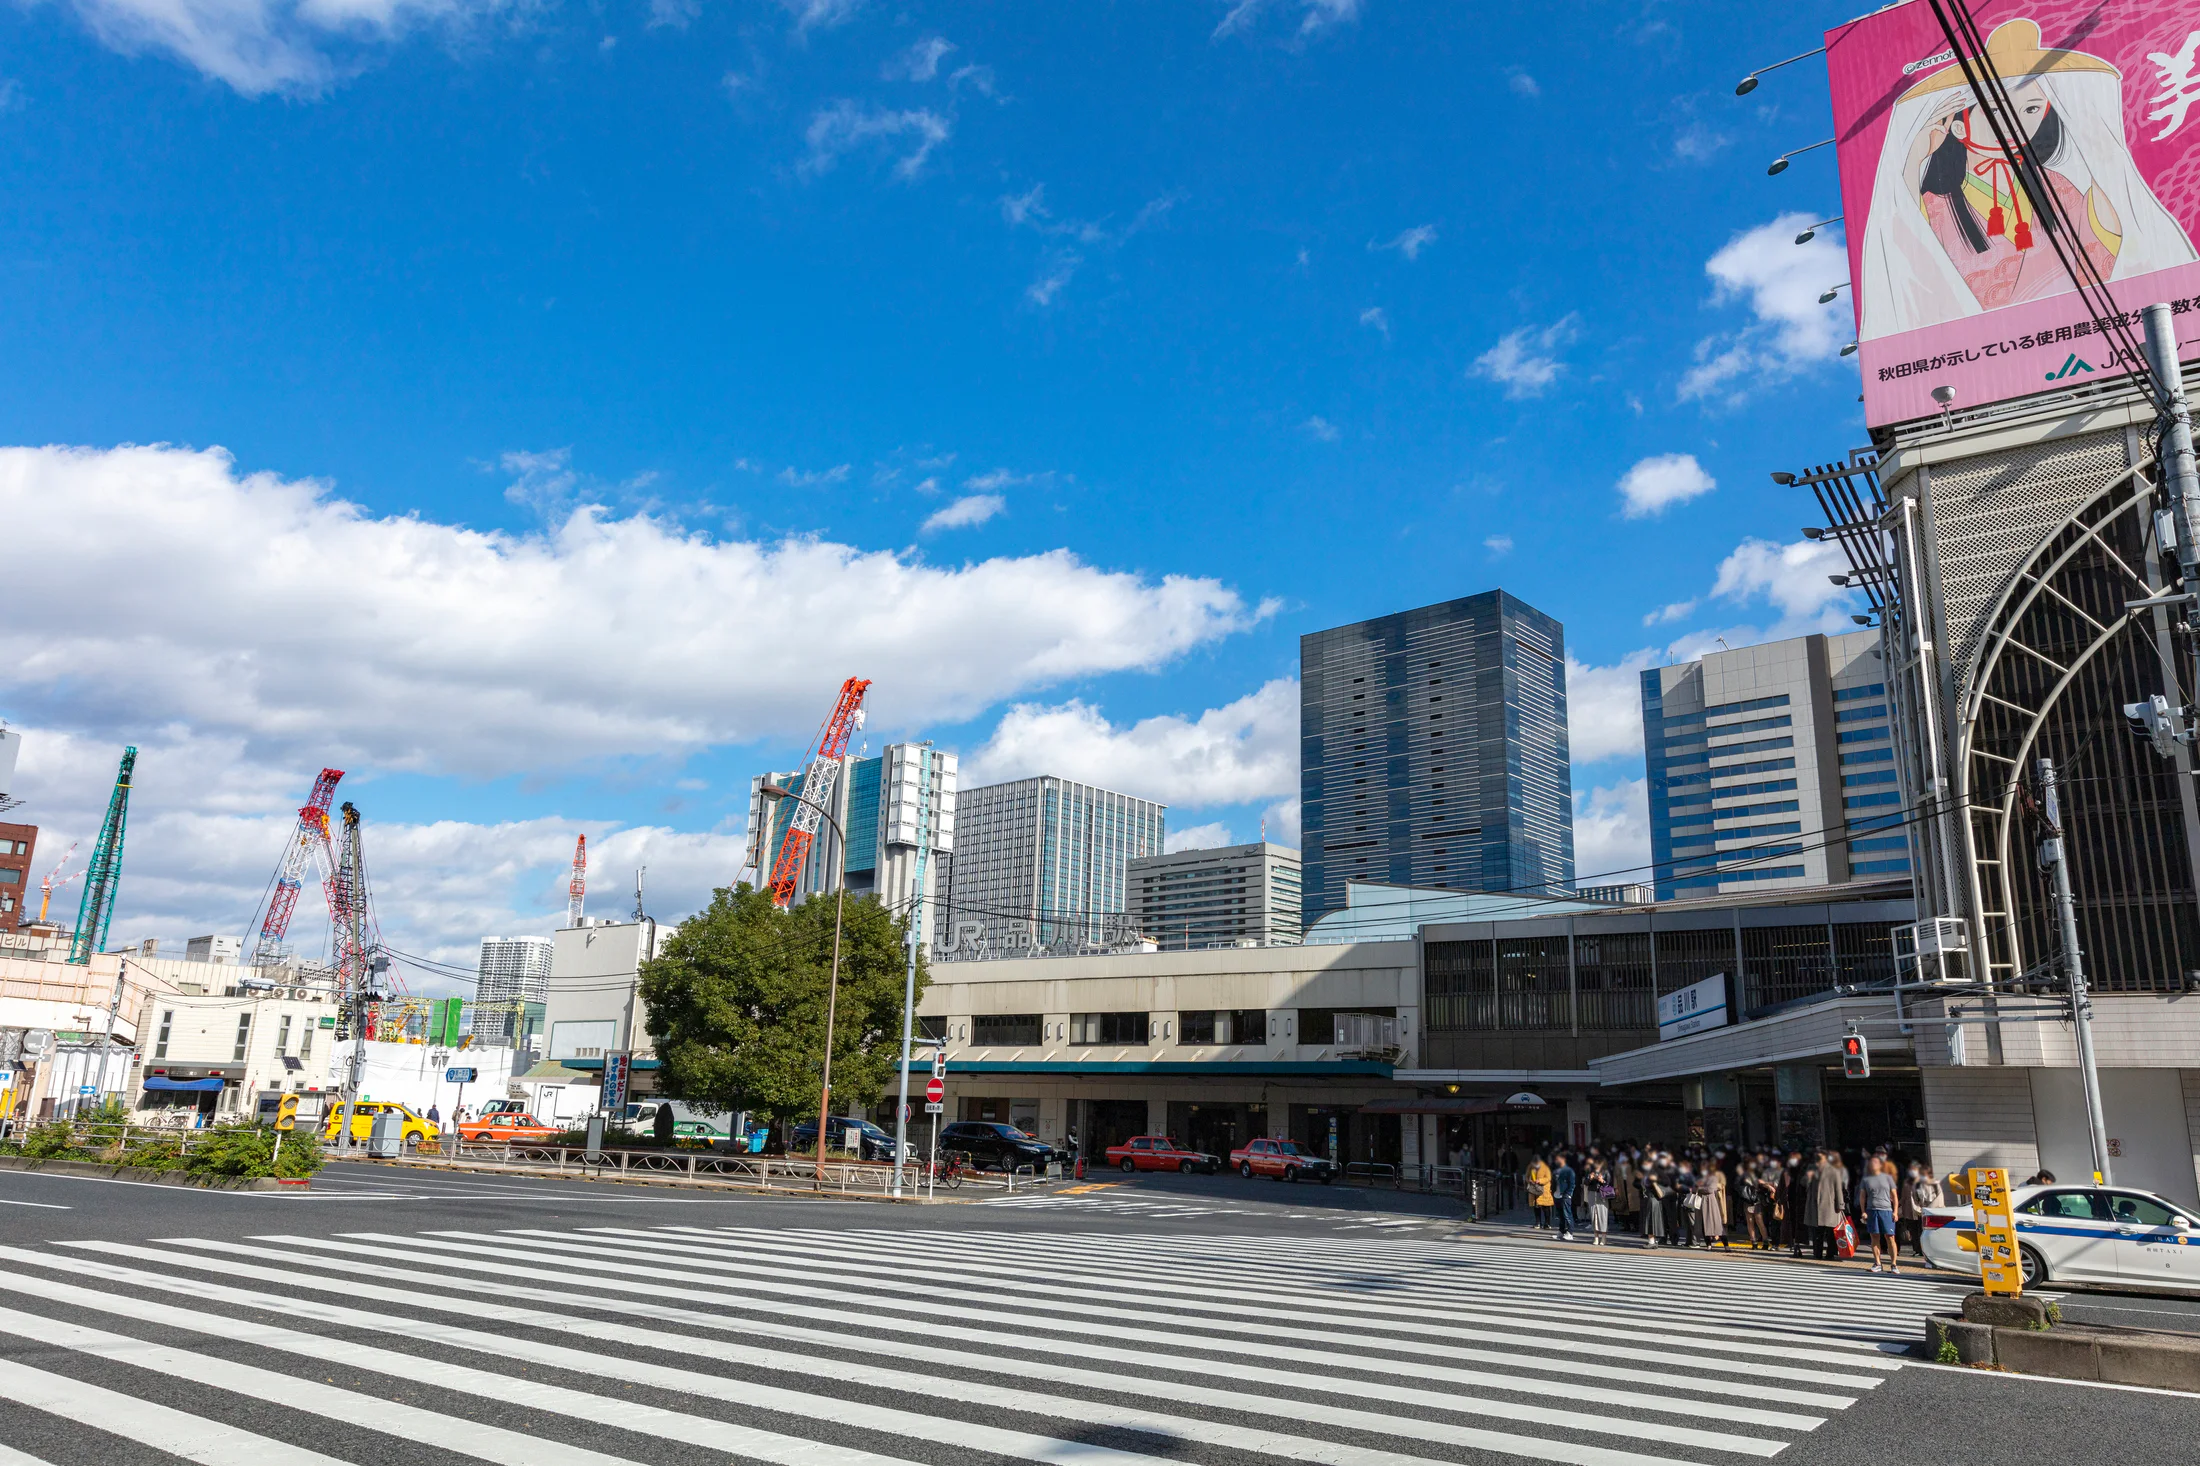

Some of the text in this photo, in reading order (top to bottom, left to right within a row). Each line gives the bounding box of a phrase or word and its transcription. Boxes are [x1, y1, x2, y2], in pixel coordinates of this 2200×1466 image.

[938, 912, 1138, 953] JR 品川駅
[1678, 989, 1697, 1015] 品川駅
